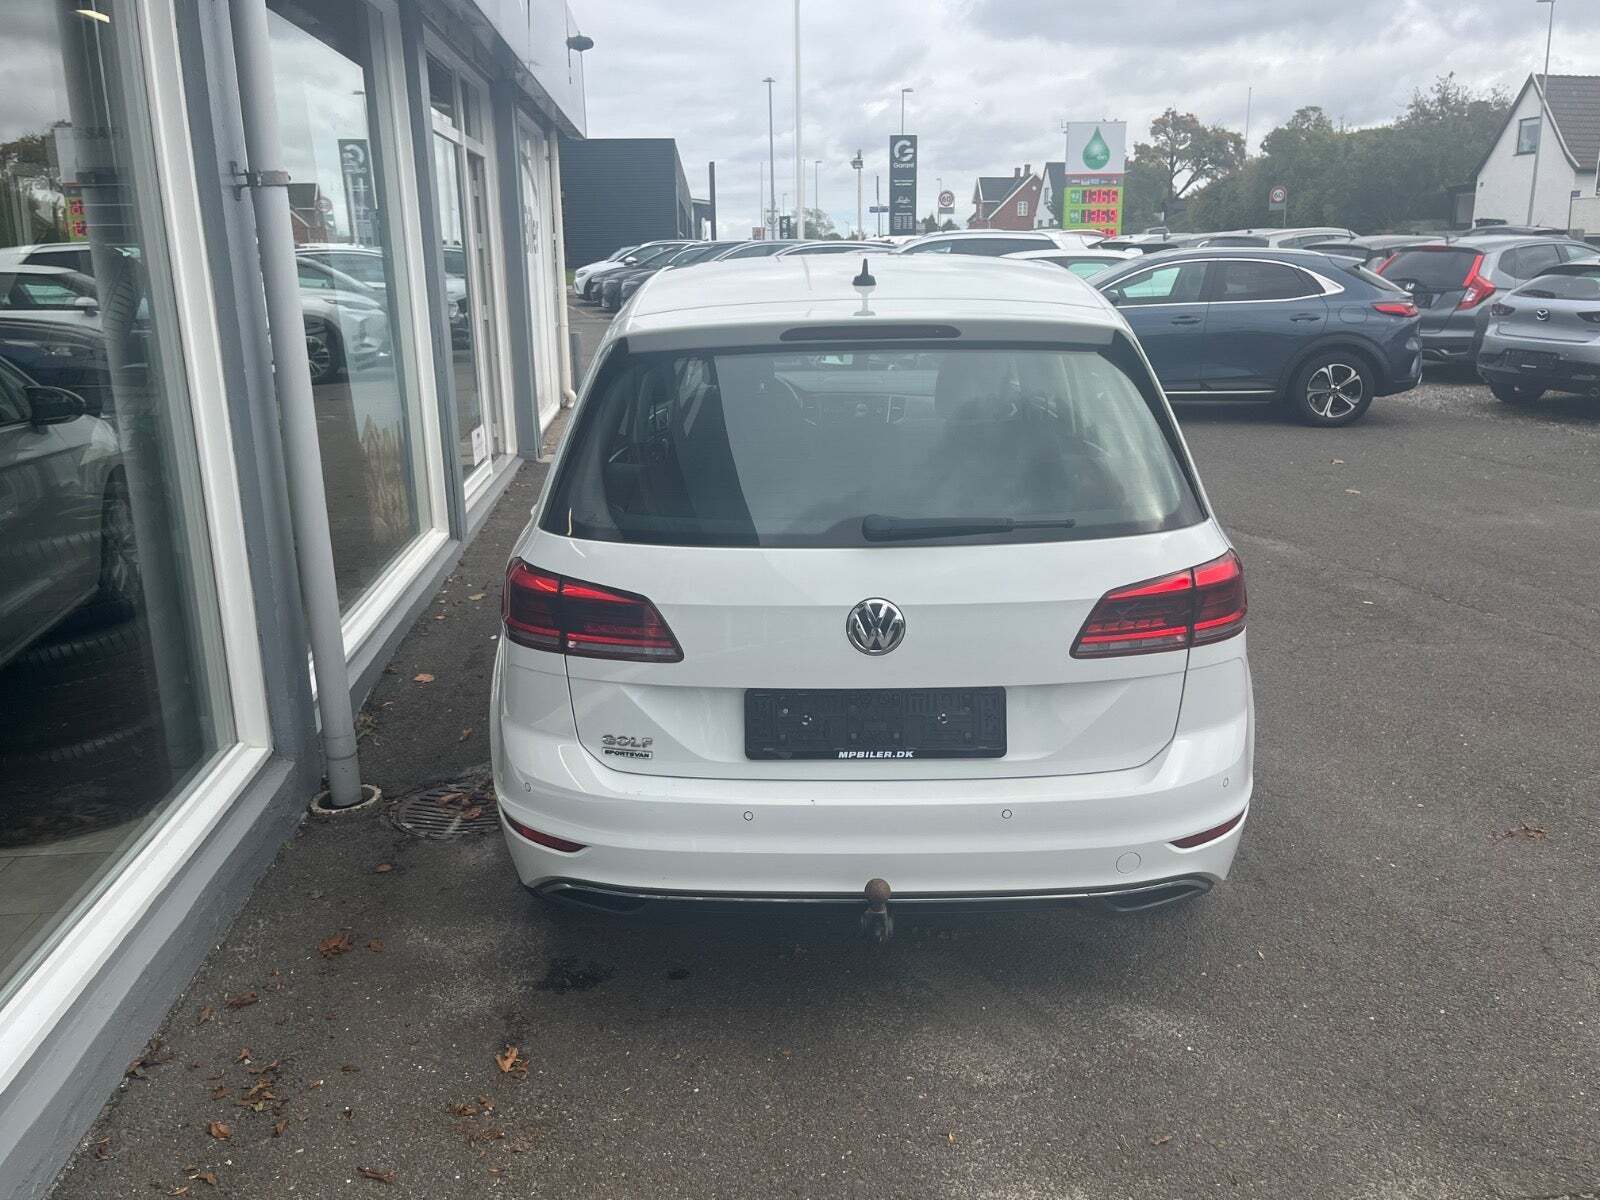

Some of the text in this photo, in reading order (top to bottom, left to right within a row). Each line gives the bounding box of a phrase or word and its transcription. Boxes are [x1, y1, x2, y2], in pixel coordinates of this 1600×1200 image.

[602, 735, 653, 748] GOLF
[604, 749, 650, 758] SPORTSVAN
[838, 751, 914, 759] MPBILER.DK
